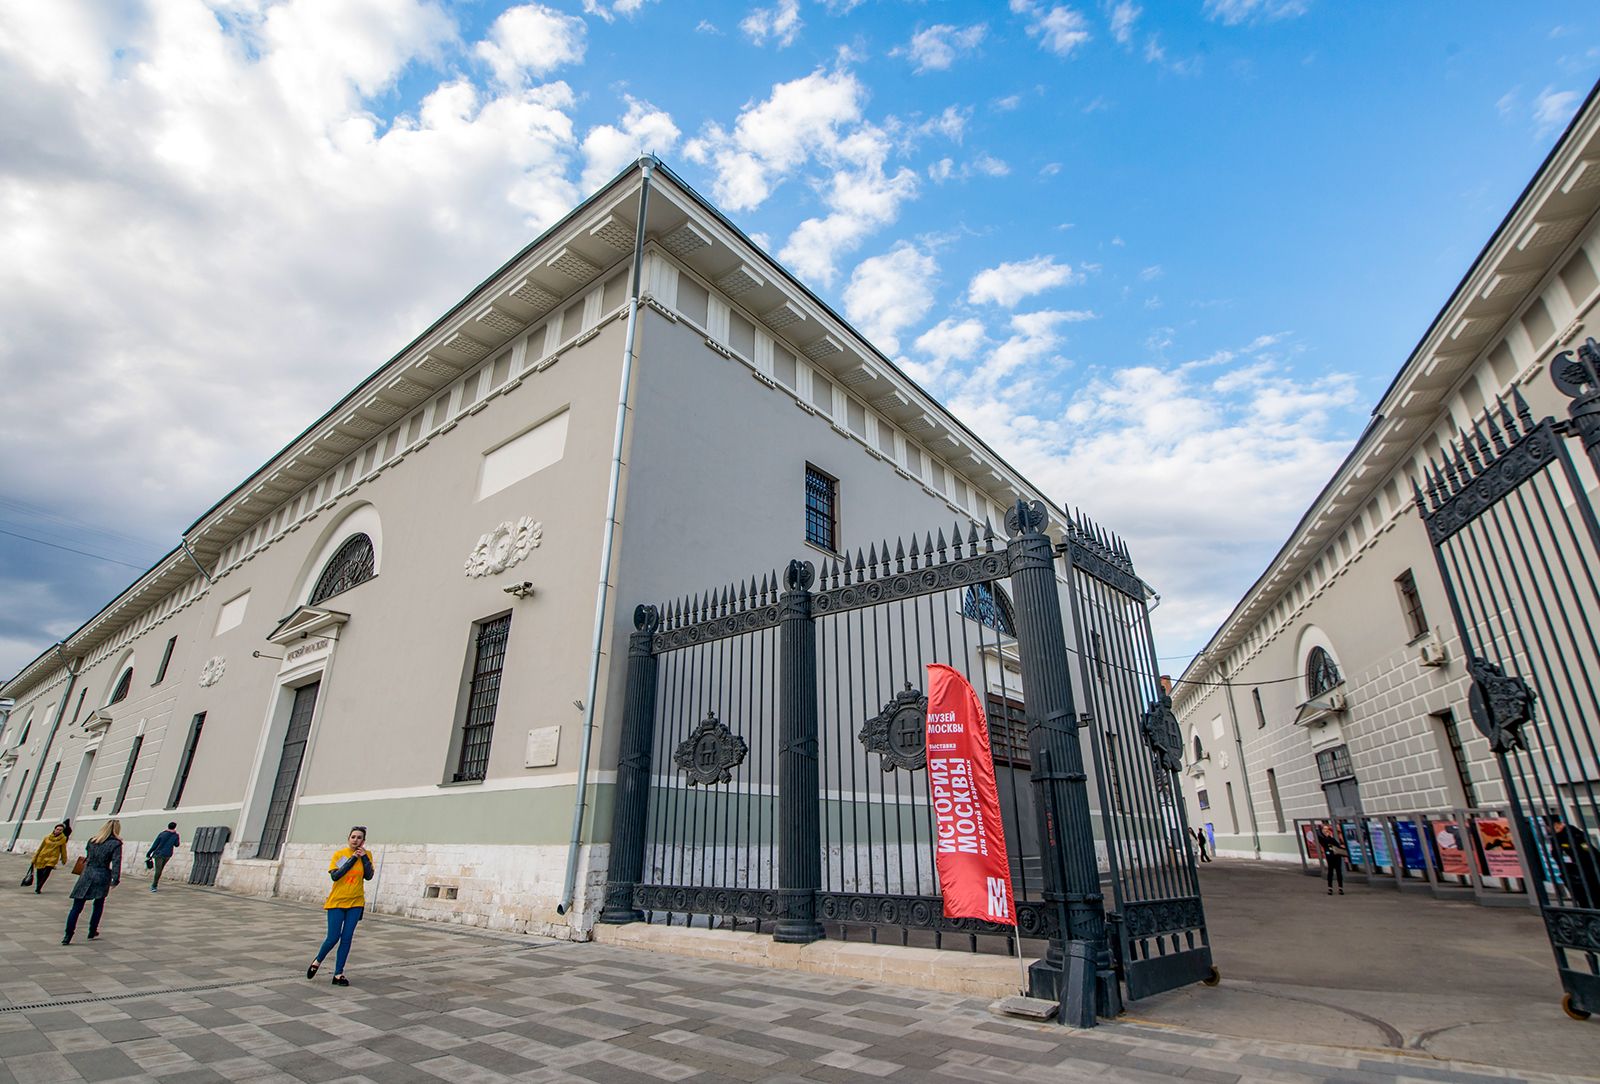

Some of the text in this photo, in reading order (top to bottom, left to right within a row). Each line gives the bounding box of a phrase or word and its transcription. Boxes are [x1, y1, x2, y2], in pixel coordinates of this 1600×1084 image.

[927, 711, 956, 723] МУЗЕЙ
[928, 724, 964, 734] МОСКВЫ
[966, 759, 979, 800] взрослых
[930, 758, 957, 853] ИСТОРИЯ
[949, 758, 978, 854] МОСКВЫ
[974, 810, 986, 837] детей
[980, 838, 988, 857] для
